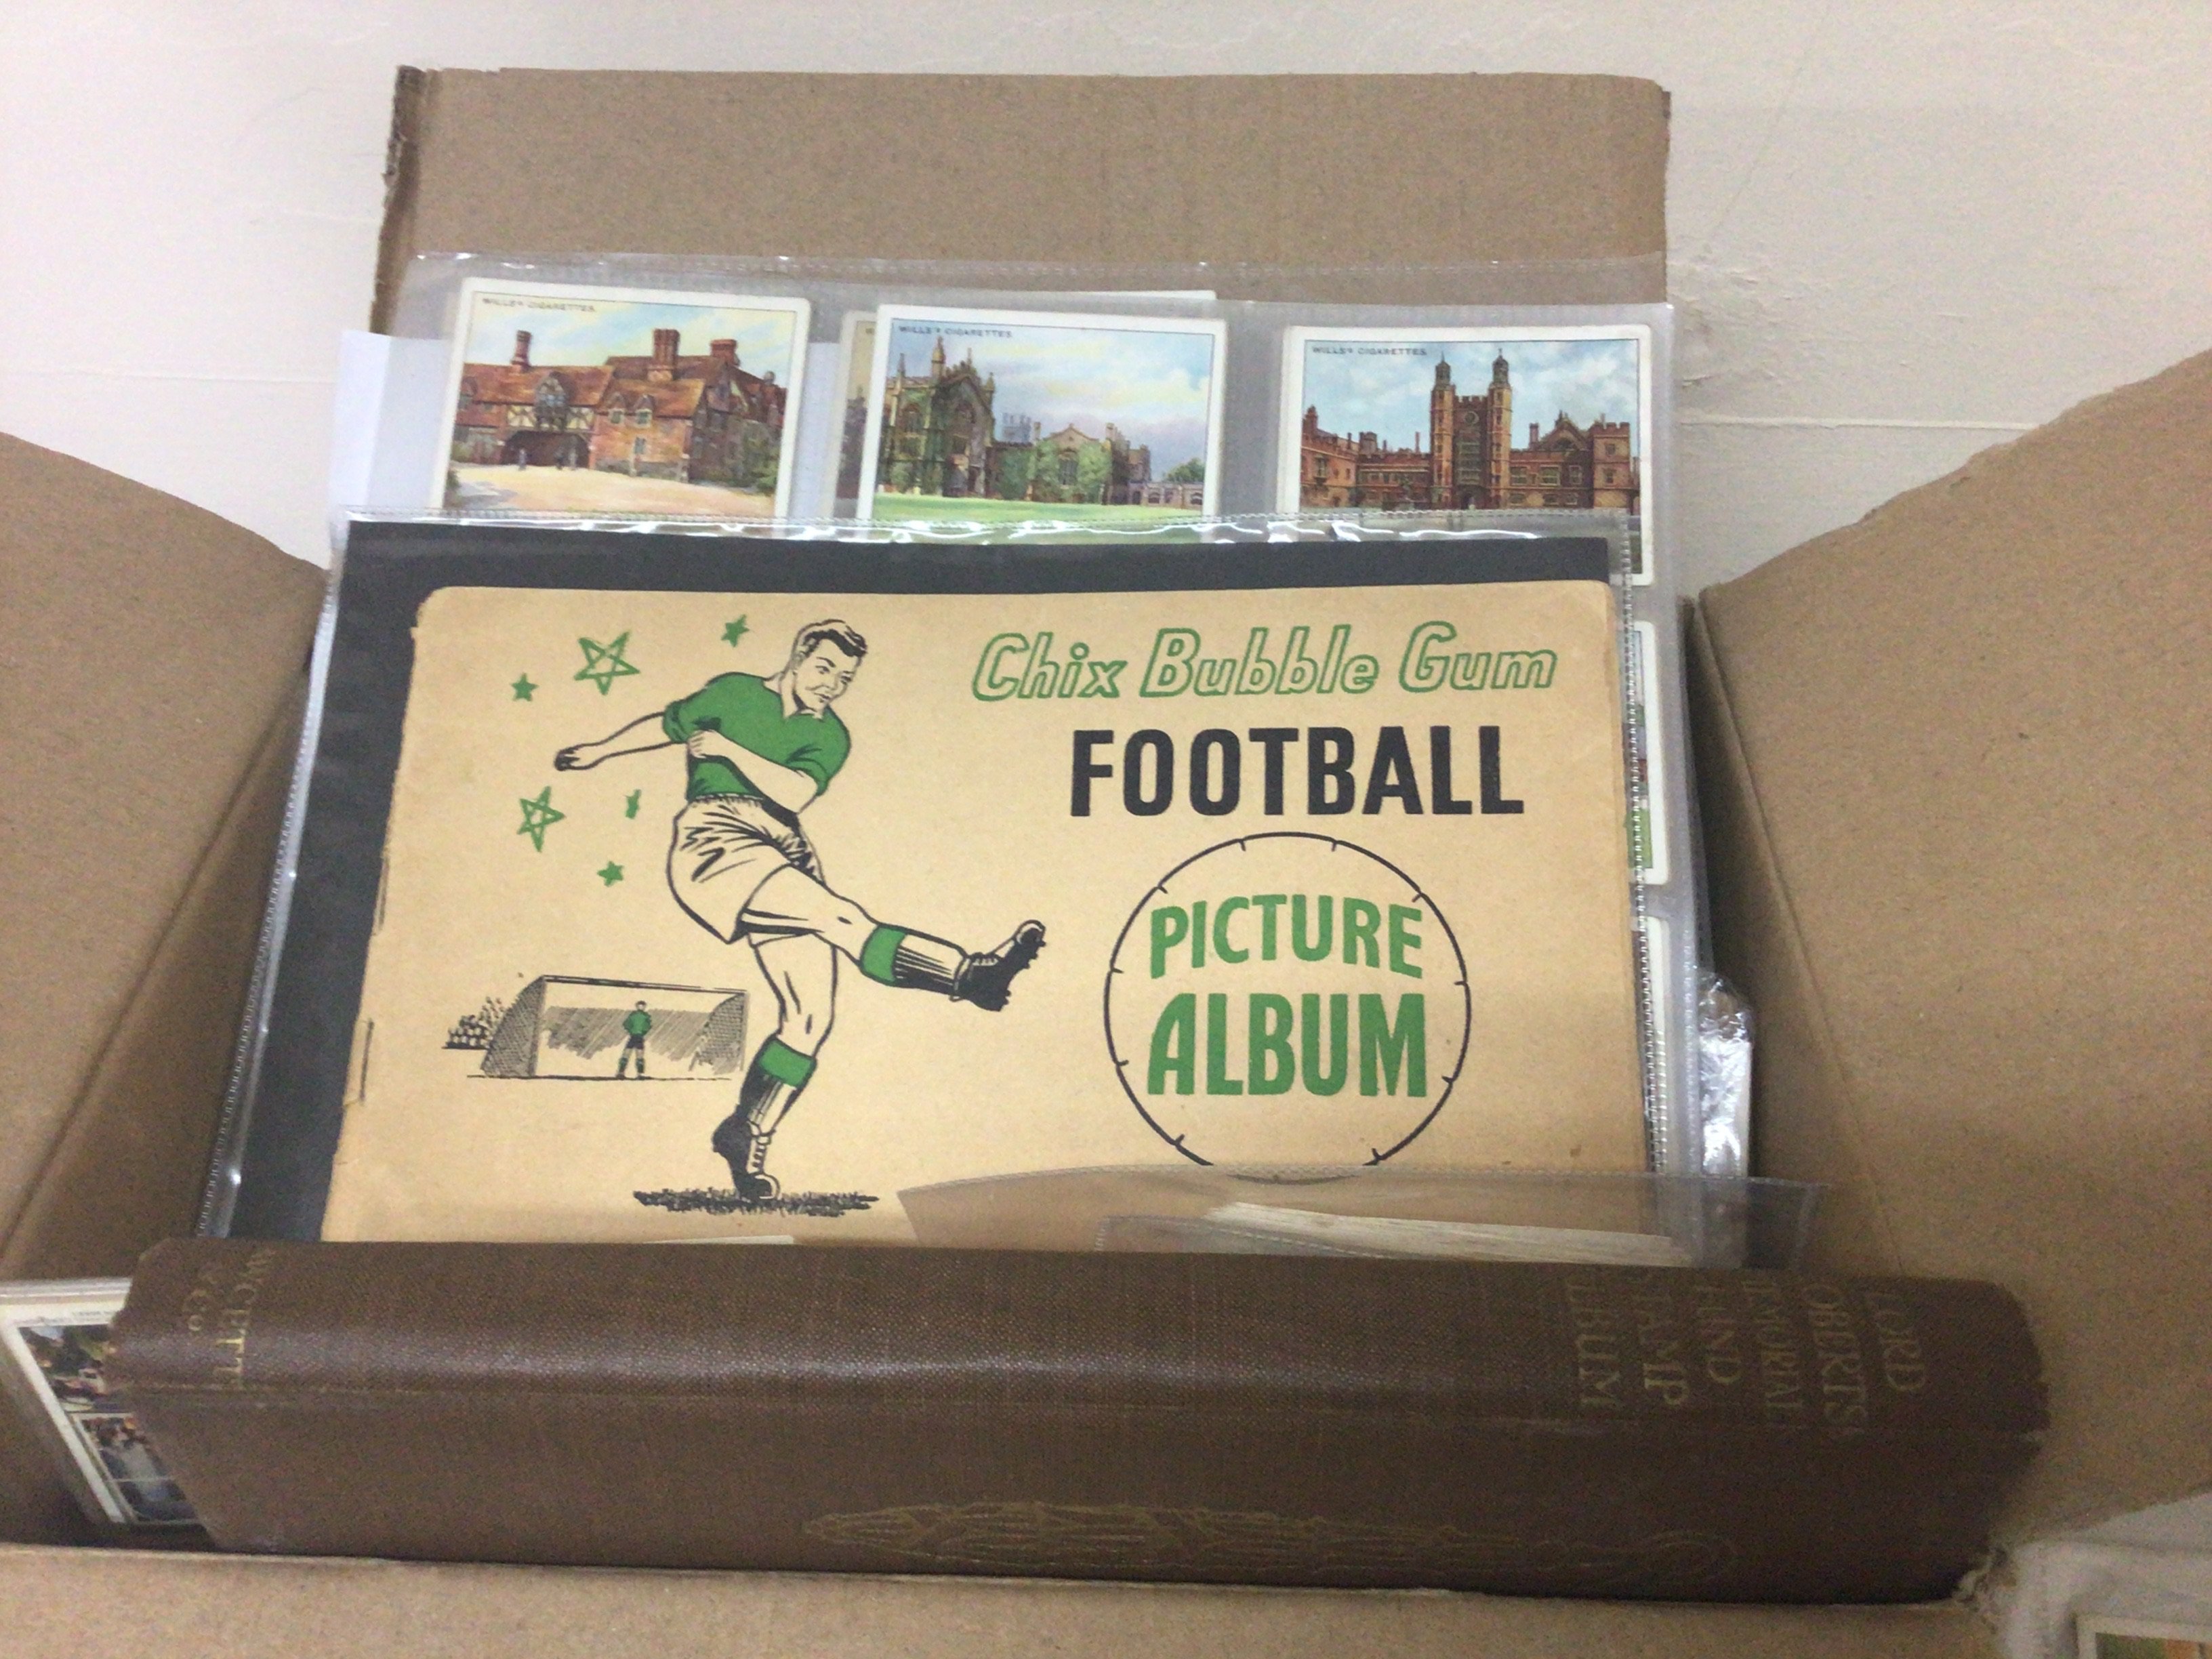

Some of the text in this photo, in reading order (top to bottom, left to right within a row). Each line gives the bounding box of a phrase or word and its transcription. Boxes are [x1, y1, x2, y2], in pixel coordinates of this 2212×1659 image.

[1357, 347, 1428, 356] CIGARETTES
[972, 620, 1558, 701] Chix Bubble Gum
[1070, 725, 1525, 817] FOOTBALL
[1150, 894, 1422, 979] PICTURE
[1147, 992, 1428, 1098] ALBUM
[1633, 1286, 1690, 1406] TAMP
[1802, 1283, 1868, 1424] OBERTS
